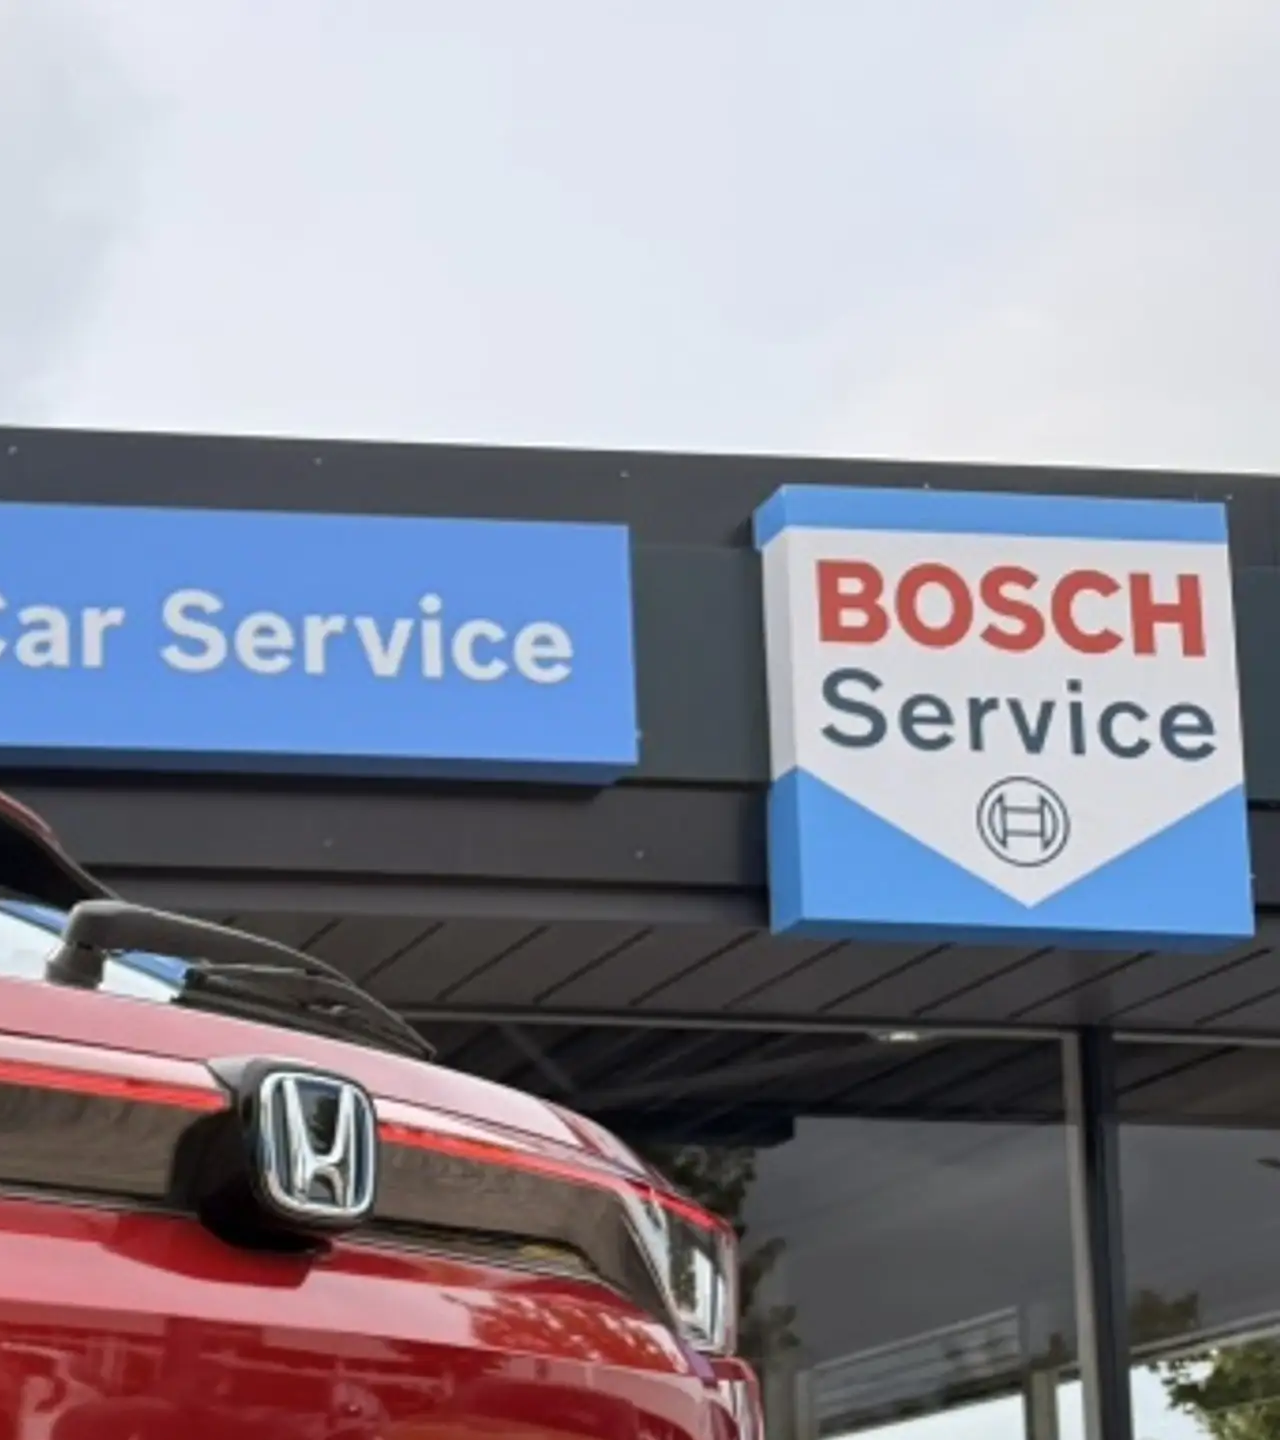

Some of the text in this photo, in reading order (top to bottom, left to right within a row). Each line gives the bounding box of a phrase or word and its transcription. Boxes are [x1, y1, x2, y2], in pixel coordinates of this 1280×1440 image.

[160, 588, 574, 683] Service
[816, 559, 1206, 657] BOSCH
[821, 667, 1217, 761] Service
